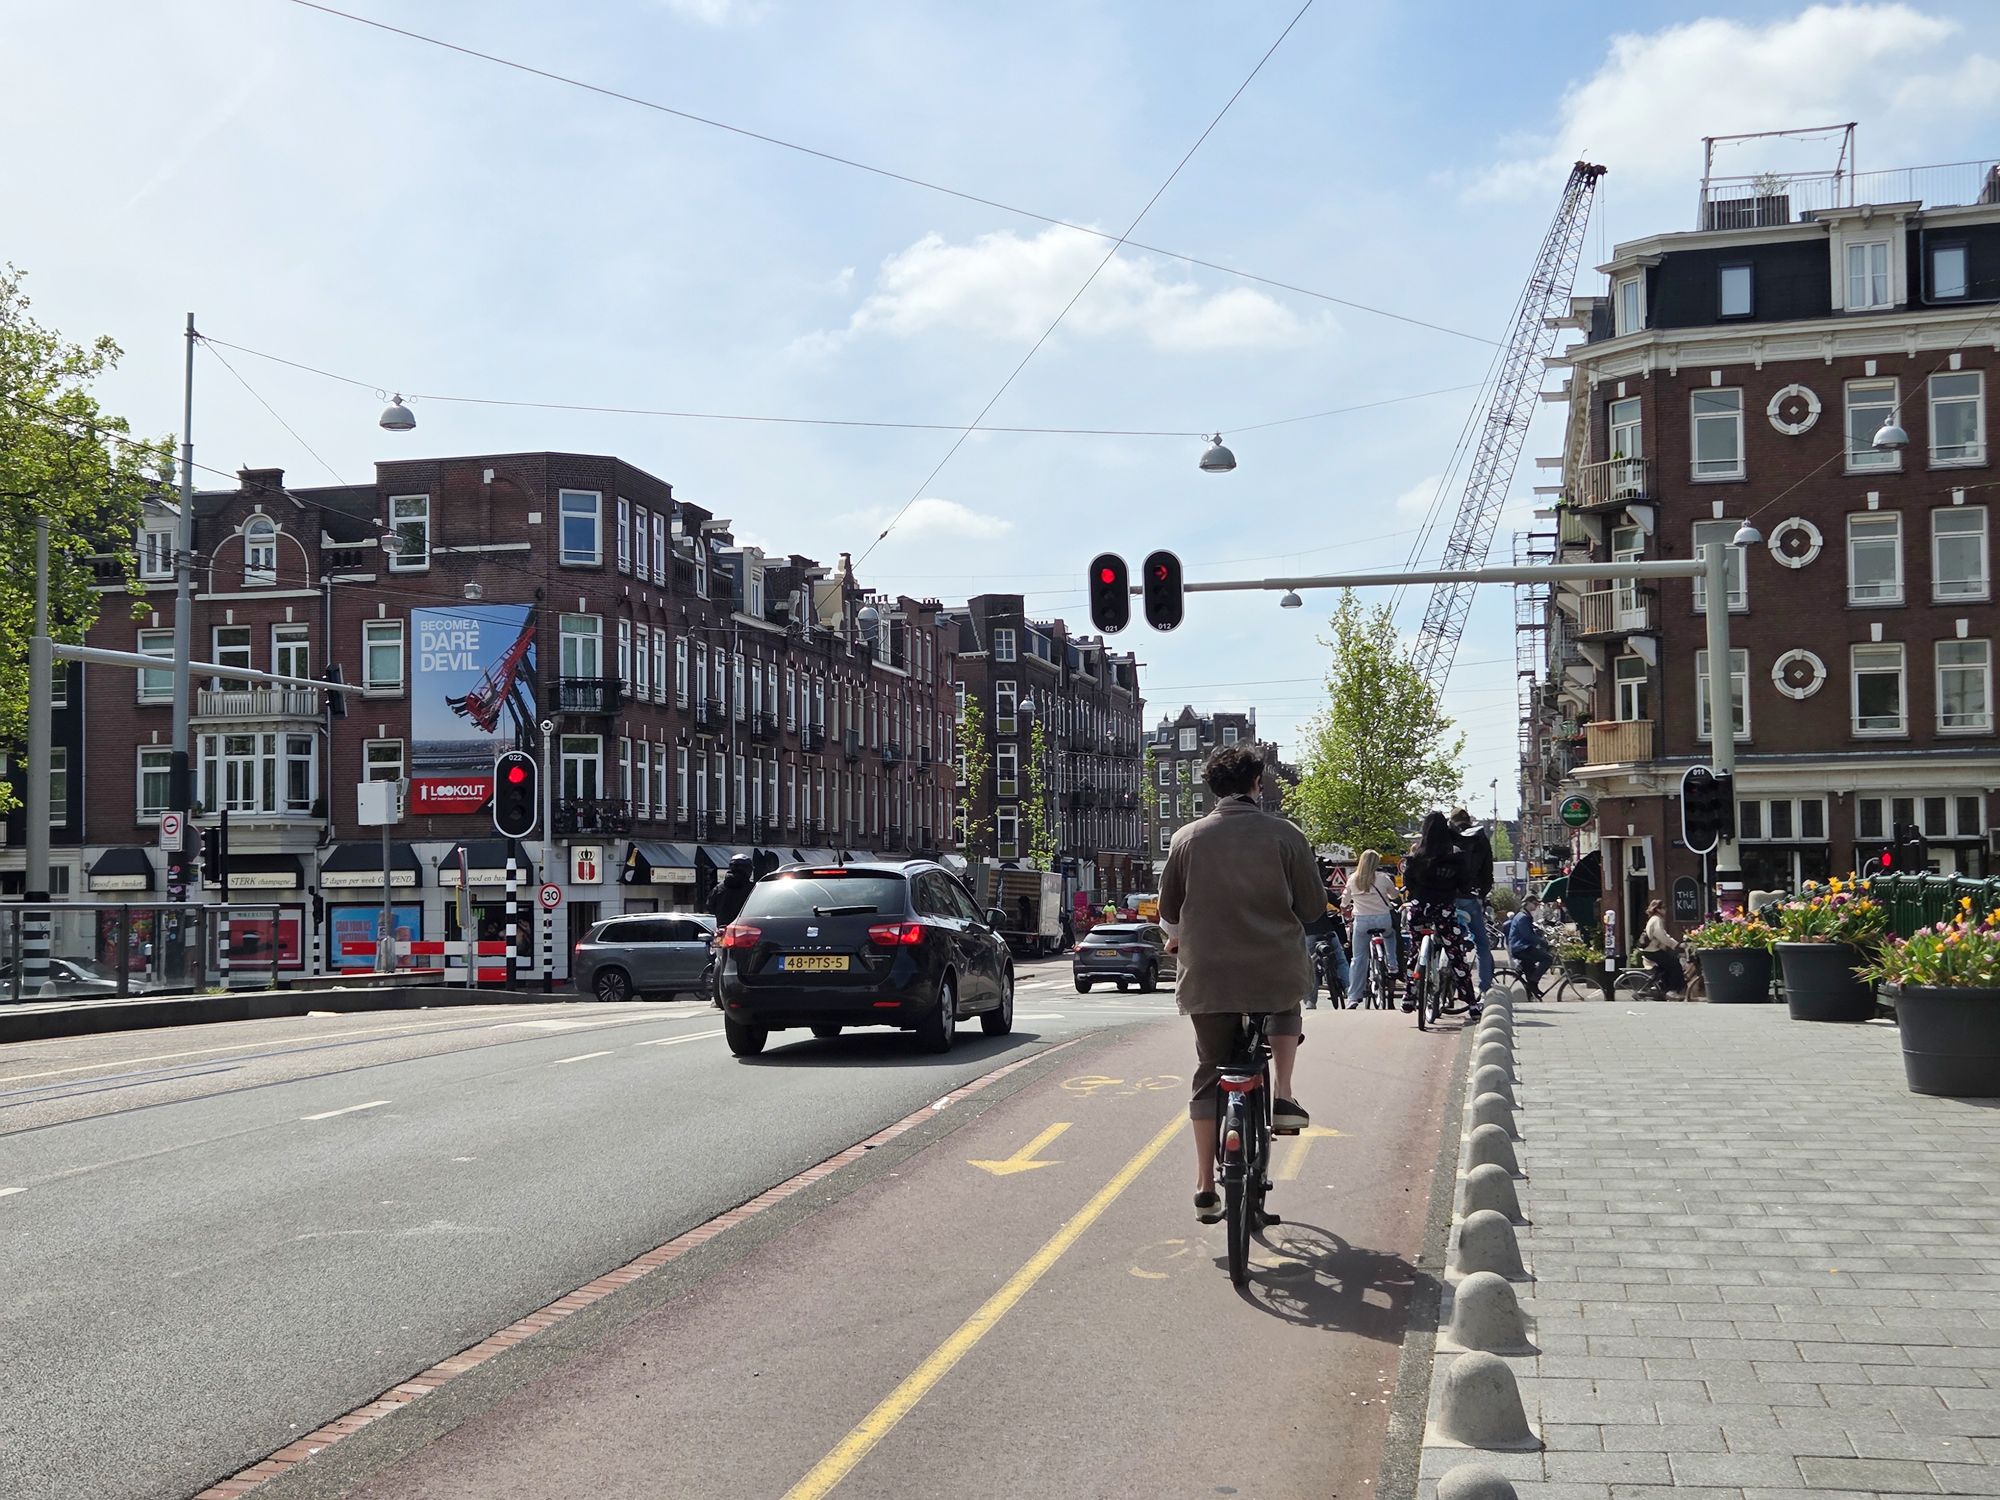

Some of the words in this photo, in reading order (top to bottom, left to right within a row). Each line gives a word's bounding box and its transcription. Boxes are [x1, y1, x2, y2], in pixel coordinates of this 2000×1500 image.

[421, 620, 470, 631] BECOME
[471, 620, 480, 630] A
[421, 631, 480, 652] DARE
[421, 652, 480, 672] DEVIL
[1692, 768, 1705, 776] 011
[430, 784, 485, 796] LOOKOUT
[230, 876, 257, 886] STERK
[377, 875, 412, 884] GPEND
[544, 890, 559, 901] 30
[1677, 891, 1696, 899] THE
[1676, 899, 1697, 910] KIWI
[787, 957, 843, 969] 48-PTS-5
